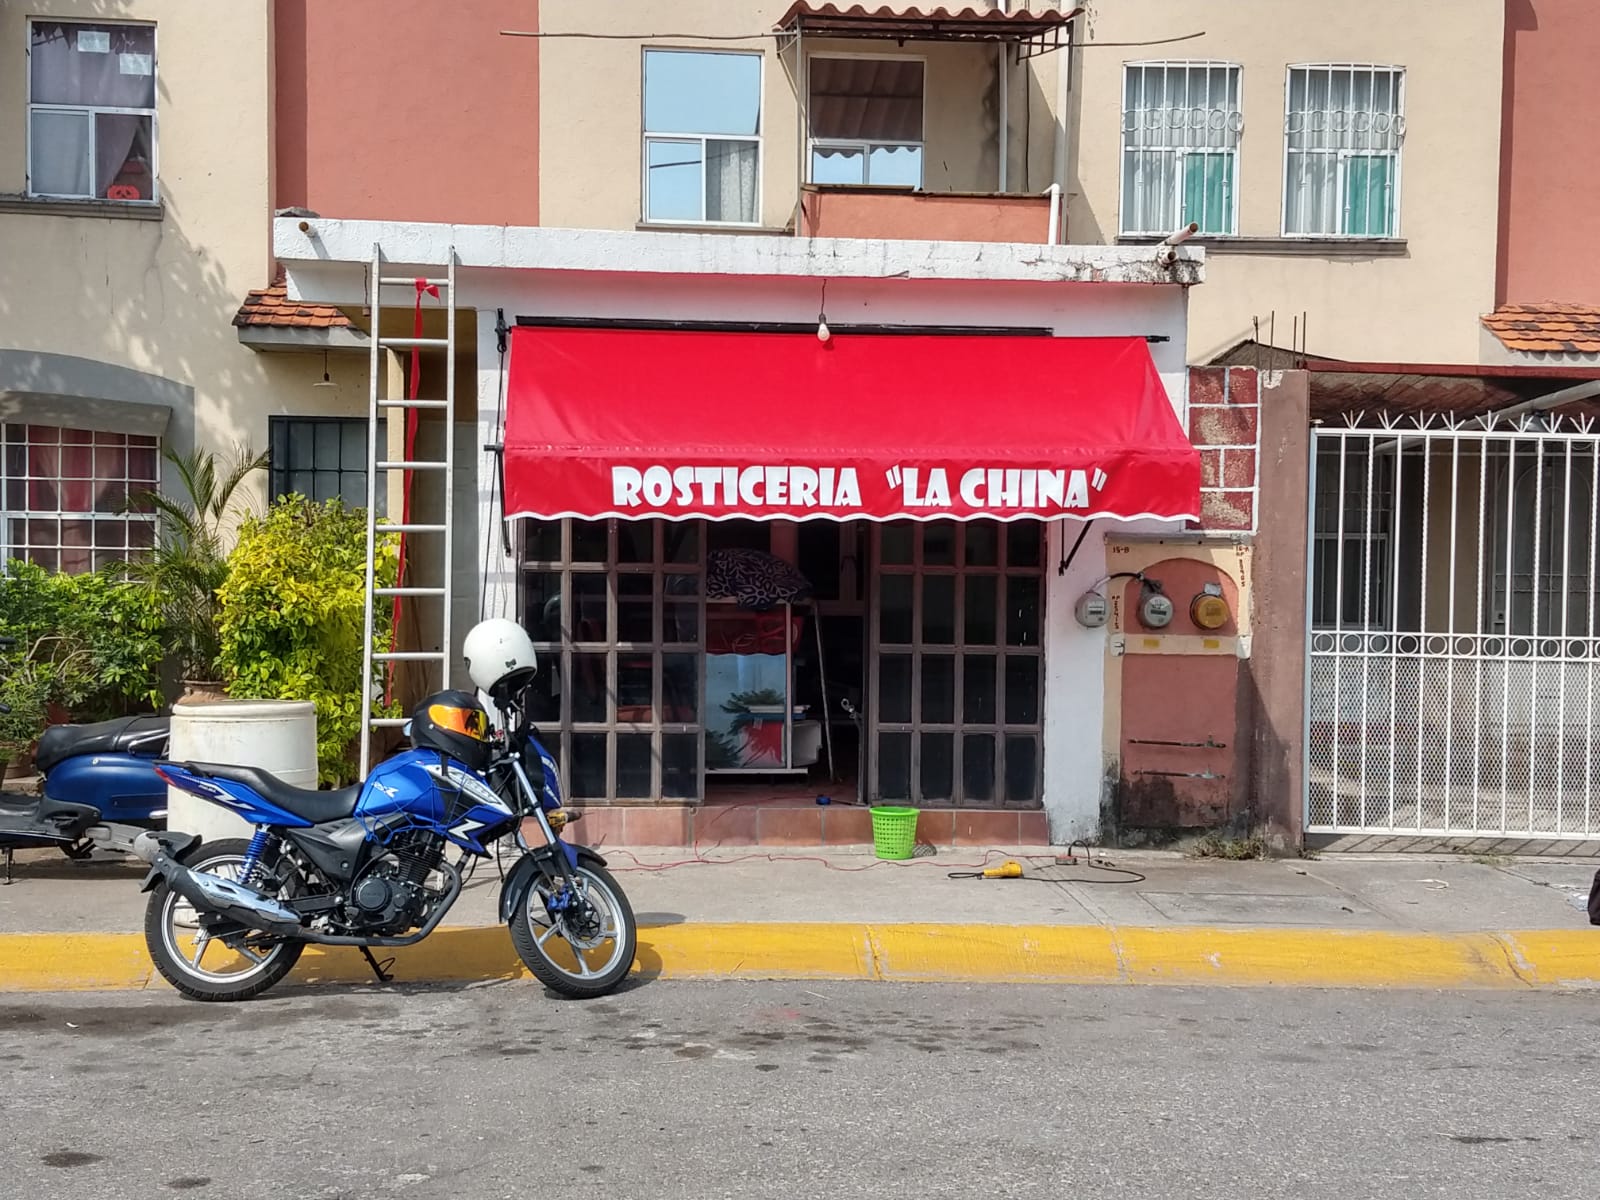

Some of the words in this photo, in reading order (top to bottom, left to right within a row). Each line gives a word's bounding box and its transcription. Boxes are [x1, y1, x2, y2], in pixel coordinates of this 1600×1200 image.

[611, 465, 862, 507] ROSTICERIA
[885, 465, 952, 507] "LA
[960, 466, 1108, 509] CHINA"
